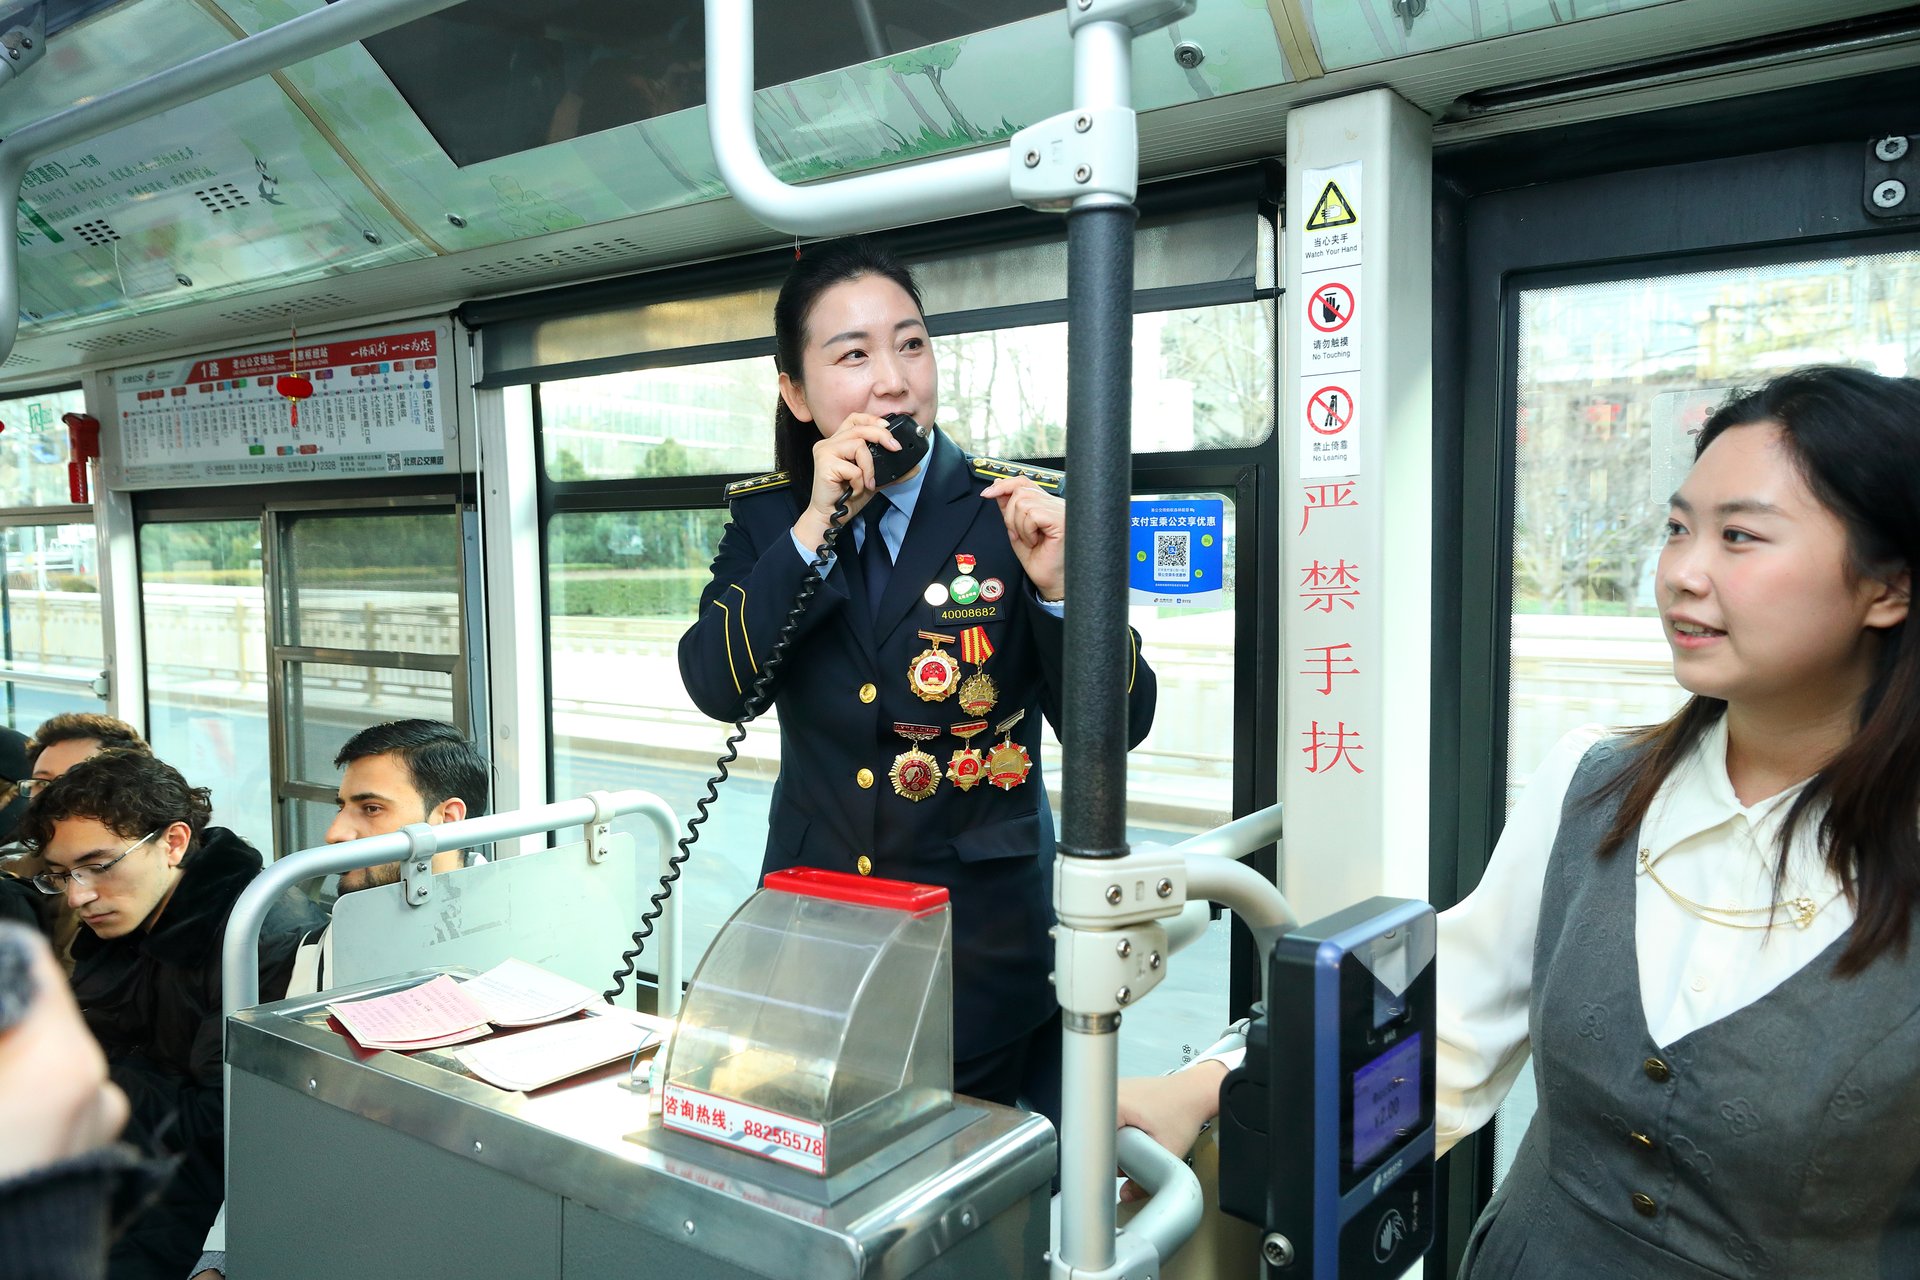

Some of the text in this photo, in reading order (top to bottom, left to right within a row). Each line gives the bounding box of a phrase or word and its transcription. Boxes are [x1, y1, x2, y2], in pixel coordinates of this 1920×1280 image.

[1314, 232, 1349, 248] 当心夹手
[1305, 244, 1358, 259] Watch Your Hand
[1313, 336, 1349, 350] 请勿触摸
[1323, 351, 1351, 359] Touching
[1323, 454, 1348, 462] Leaning
[1130, 516, 1216, 527] 支付宝乘公交享优惠
[941, 606, 996, 620] 40008682
[1298, 480, 1365, 774] 严禁手扶
[744, 1120, 822, 1157] 88255578
